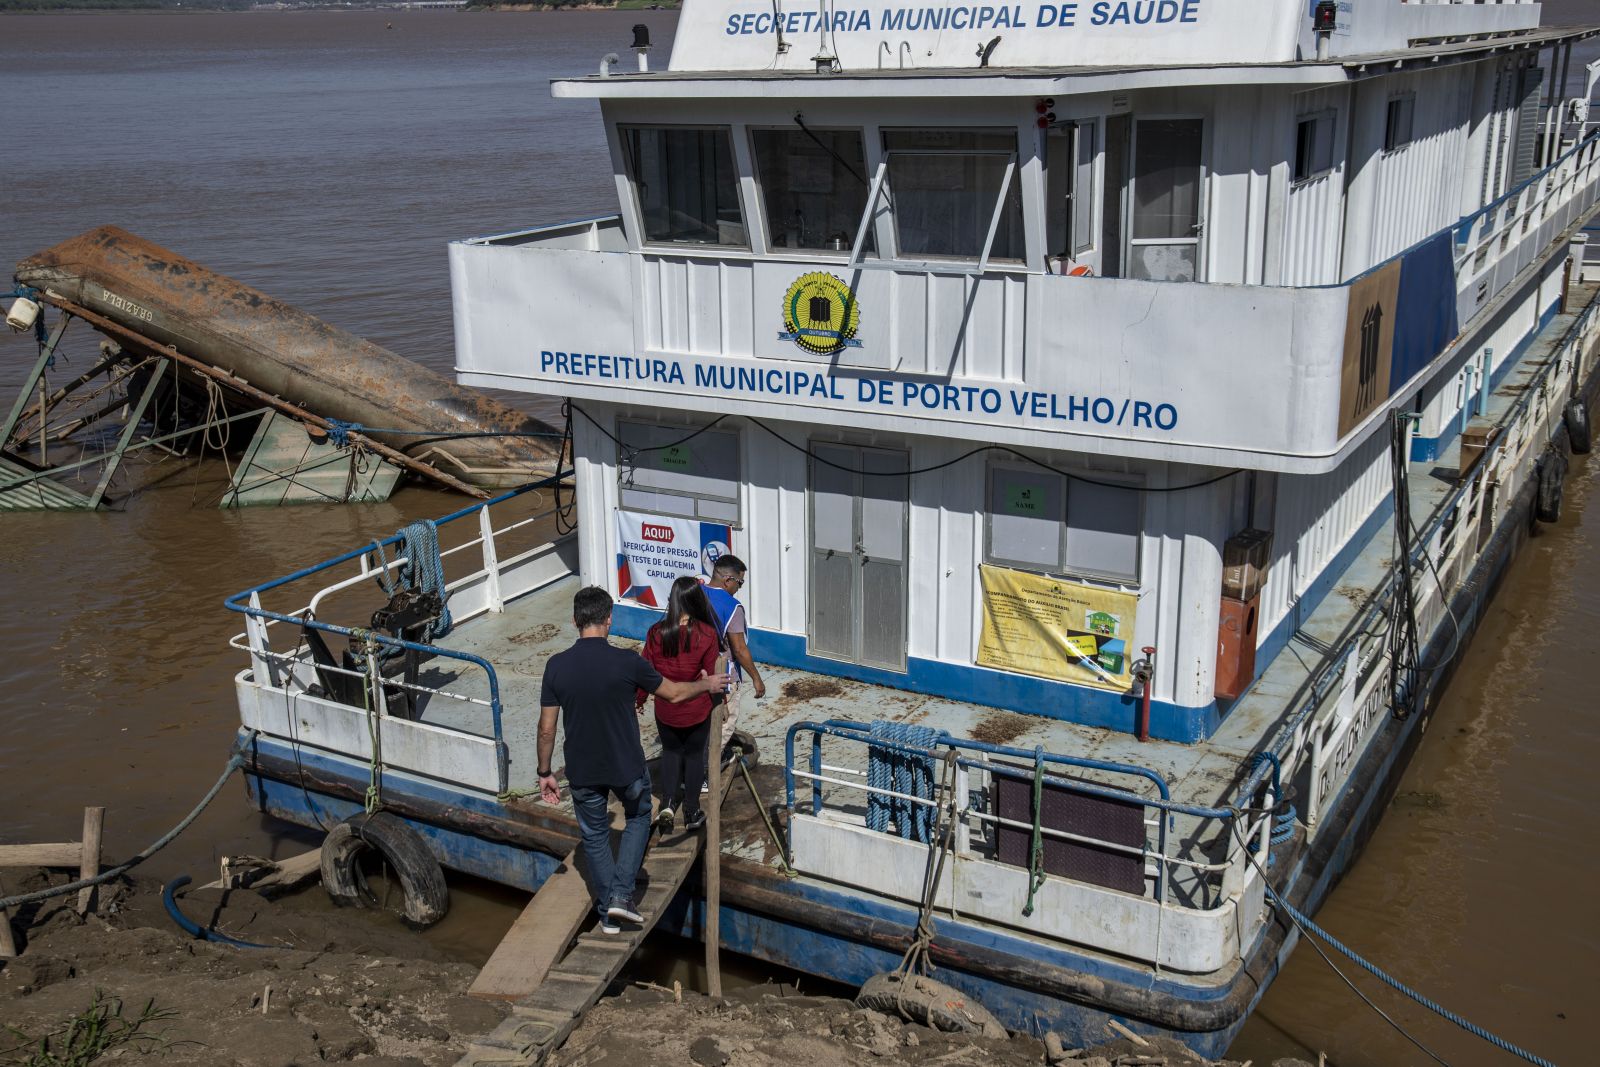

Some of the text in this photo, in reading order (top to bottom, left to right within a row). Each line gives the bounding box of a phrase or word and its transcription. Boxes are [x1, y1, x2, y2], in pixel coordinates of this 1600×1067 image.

[726, 10, 871, 36] SECRETARIA
[880, 6, 1026, 31] MUNICIPAL
[1036, 4, 1078, 28] DE
[103, 289, 153, 322] GRAZIELA
[540, 350, 1178, 431] PREFEITURA MUNICIPAL DE PORTO VELHO/RO
[644, 527, 671, 540] AQUI!
[623, 541, 698, 558] AFERIÇÃO DE PRESSÃO
[632, 556, 650, 565] TESTE
[652, 558, 662, 566] DE
[663, 559, 696, 571] GLICEMIA
[646, 569, 675, 579] CAPILAR
